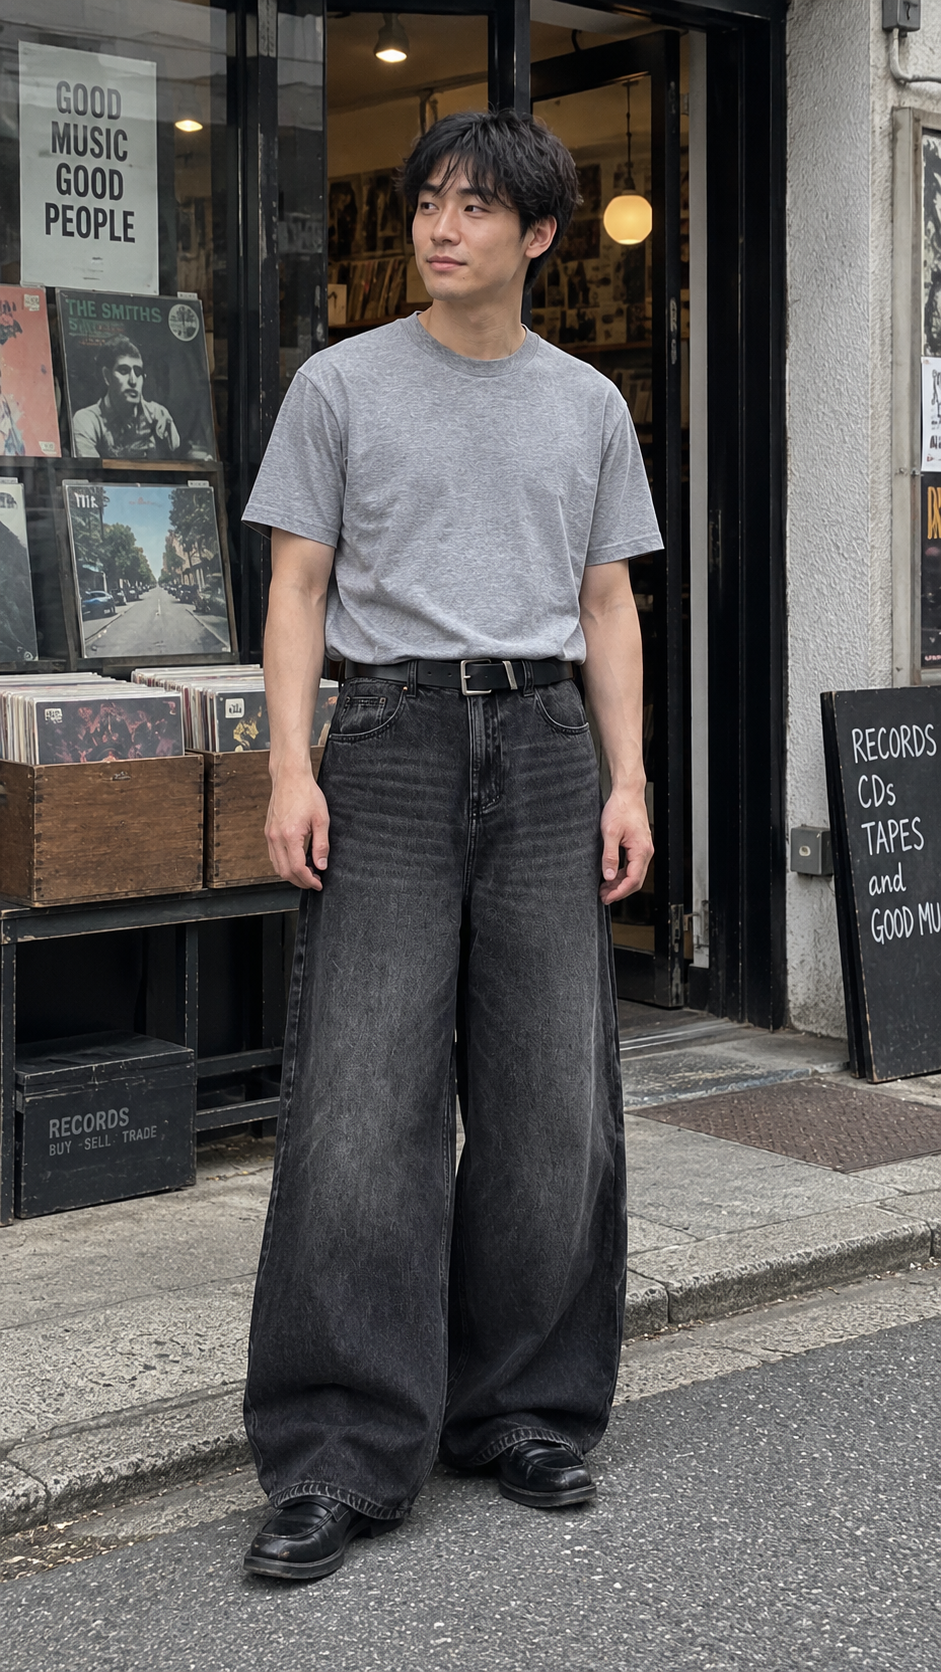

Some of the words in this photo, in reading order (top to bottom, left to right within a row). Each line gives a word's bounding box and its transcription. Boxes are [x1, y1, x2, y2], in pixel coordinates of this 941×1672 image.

[56, 81, 121, 119] GOOD
[51, 121, 127, 161] MUSIC
[56, 163, 123, 200] GOOD
[45, 202, 135, 242] PEOPLE
[66, 299, 97, 317] THE
[102, 302, 161, 322] SMITHS
[852, 724, 936, 762] RECORDS
[858, 775, 895, 807] CDs
[861, 817, 924, 854] TAPES
[869, 862, 906, 895] and
[871, 906, 913, 943] GOOD
[49, 1107, 129, 1137] RECORDS
[49, 1141, 71, 1155] BUY
[122, 1126, 157, 1142] TRADE
